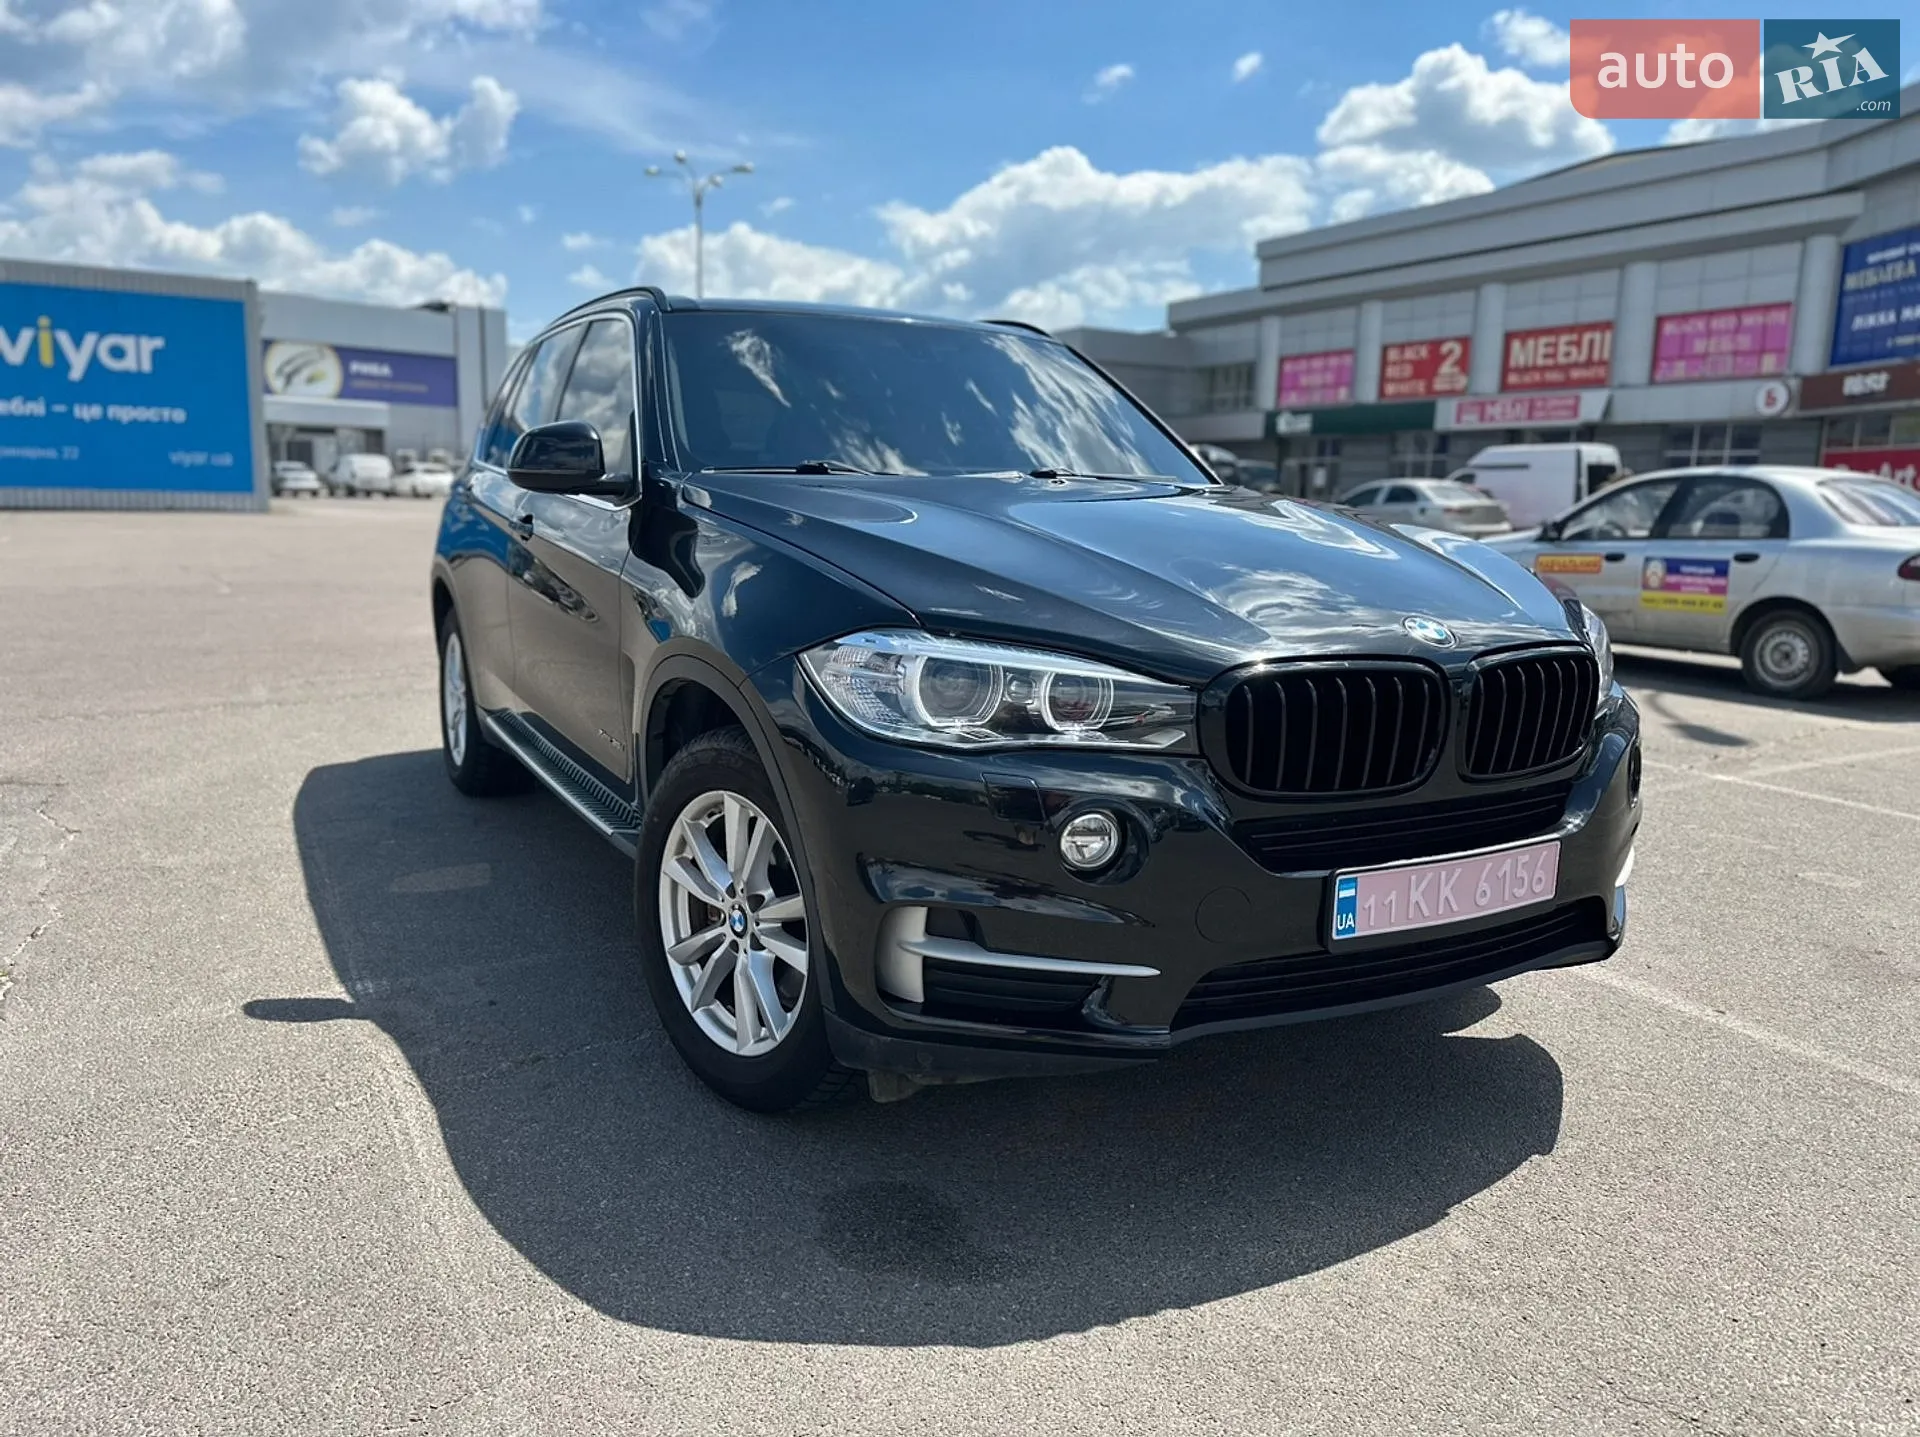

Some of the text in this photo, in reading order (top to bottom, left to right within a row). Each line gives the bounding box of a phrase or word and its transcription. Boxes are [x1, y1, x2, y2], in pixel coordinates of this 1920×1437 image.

[0, 315, 165, 382] viyar
[1439, 341, 1463, 374] 2
[1509, 330, 1613, 369] МЕБЛІ
[106, 404, 188, 425] просто
[1475, 851, 1548, 907] 6156
[1337, 913, 1355, 931] UA
